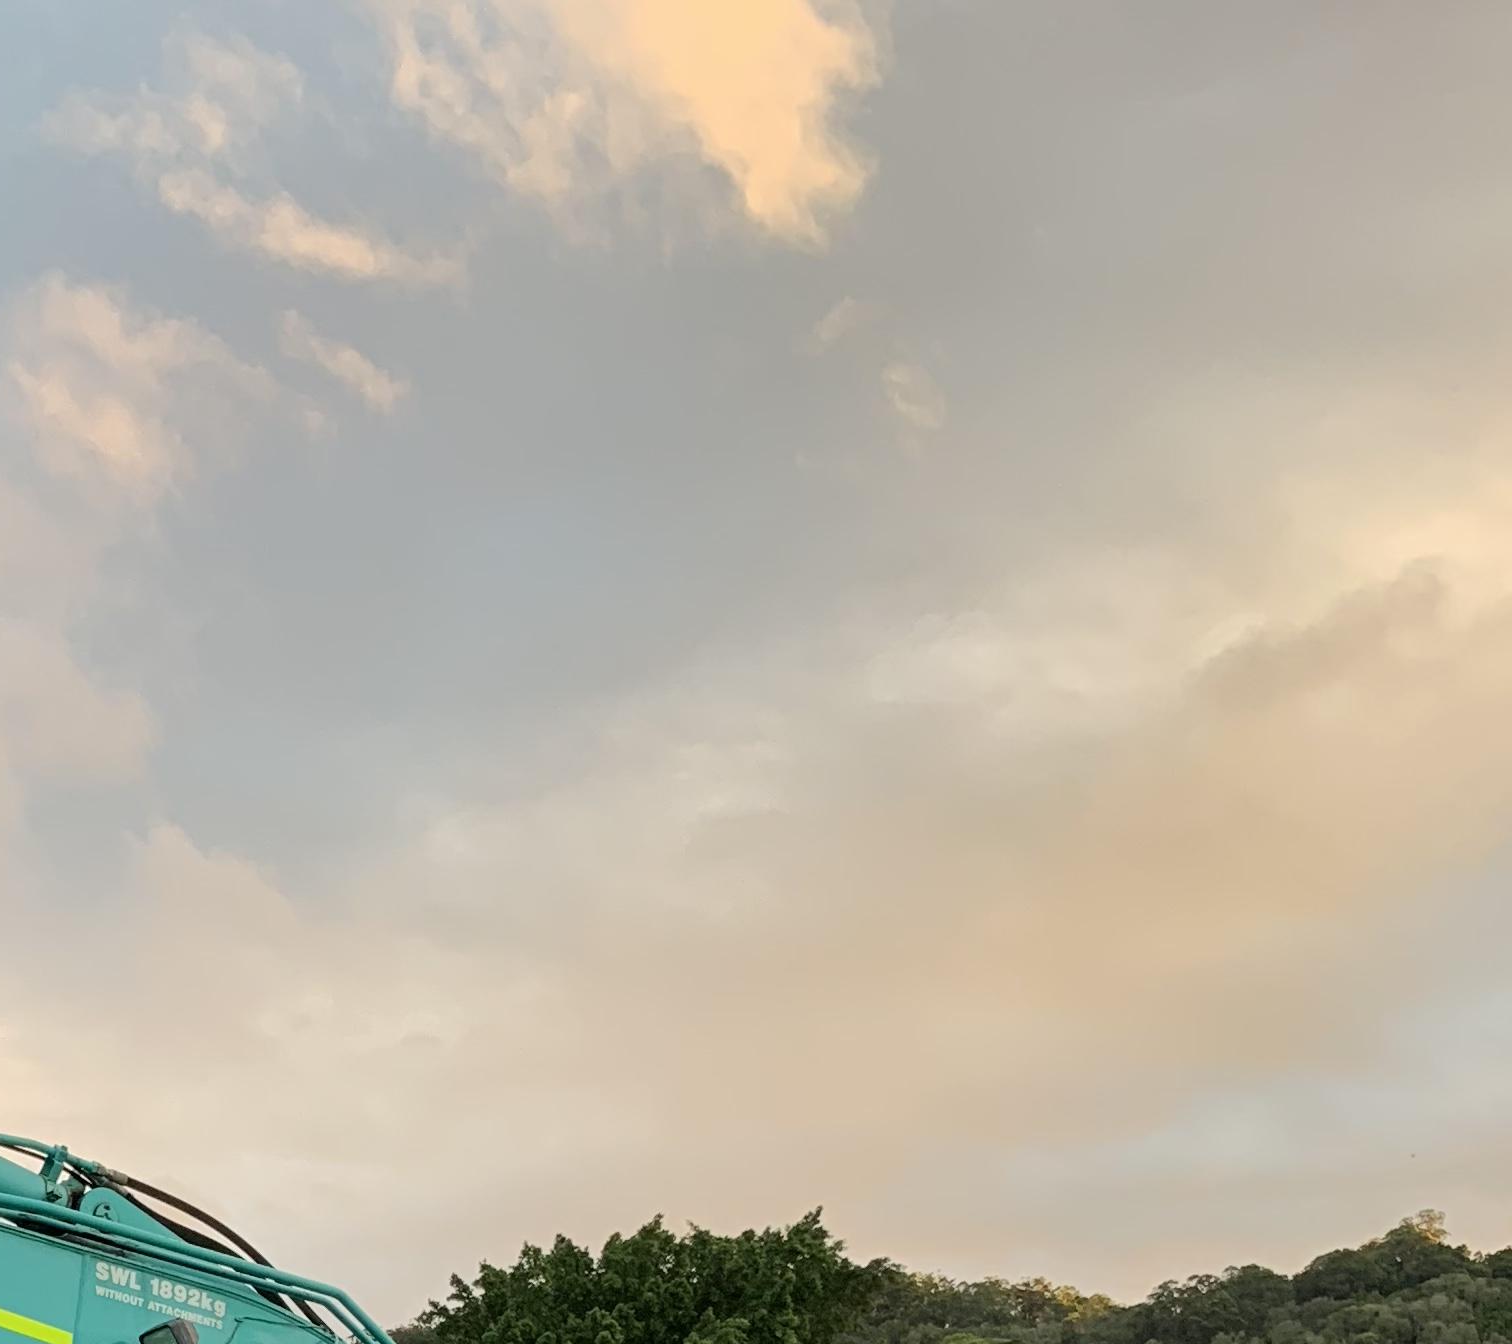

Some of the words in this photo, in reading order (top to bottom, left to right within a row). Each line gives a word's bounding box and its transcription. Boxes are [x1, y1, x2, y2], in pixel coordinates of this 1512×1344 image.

[95, 1262, 141, 1291] SWL
[150, 1278, 226, 1318] 1892kg
[95, 1285, 145, 1308] WITHOUT
[147, 1300, 223, 1330] ATTACHMENTS
